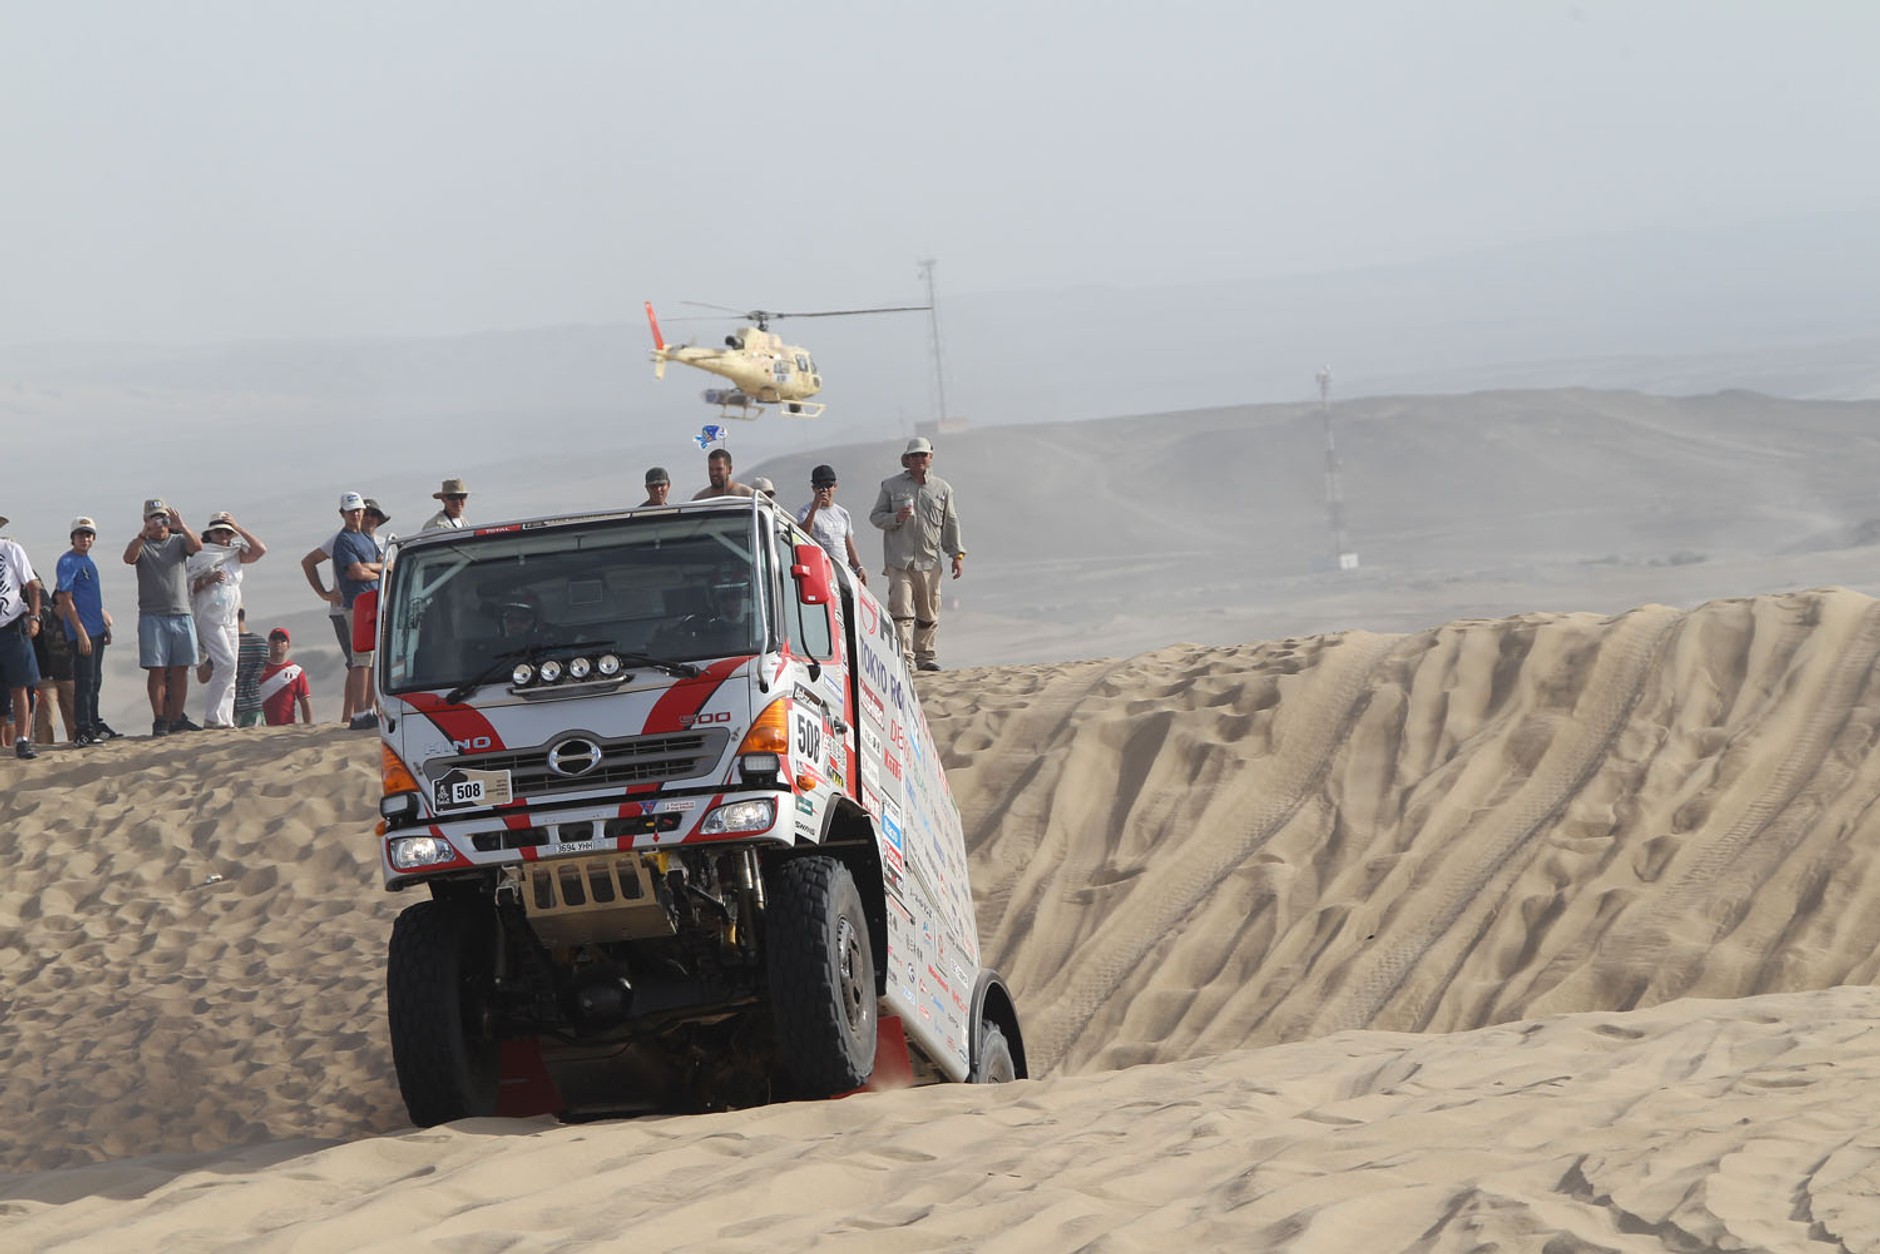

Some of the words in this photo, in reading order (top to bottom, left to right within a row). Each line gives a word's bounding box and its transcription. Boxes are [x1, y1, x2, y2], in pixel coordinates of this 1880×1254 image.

[486, 526, 510, 534] TOTAL
[860, 634, 887, 694] TOKYO
[680, 711, 731, 726] 500
[797, 713, 820, 764] 508
[457, 783, 480, 799] 508
